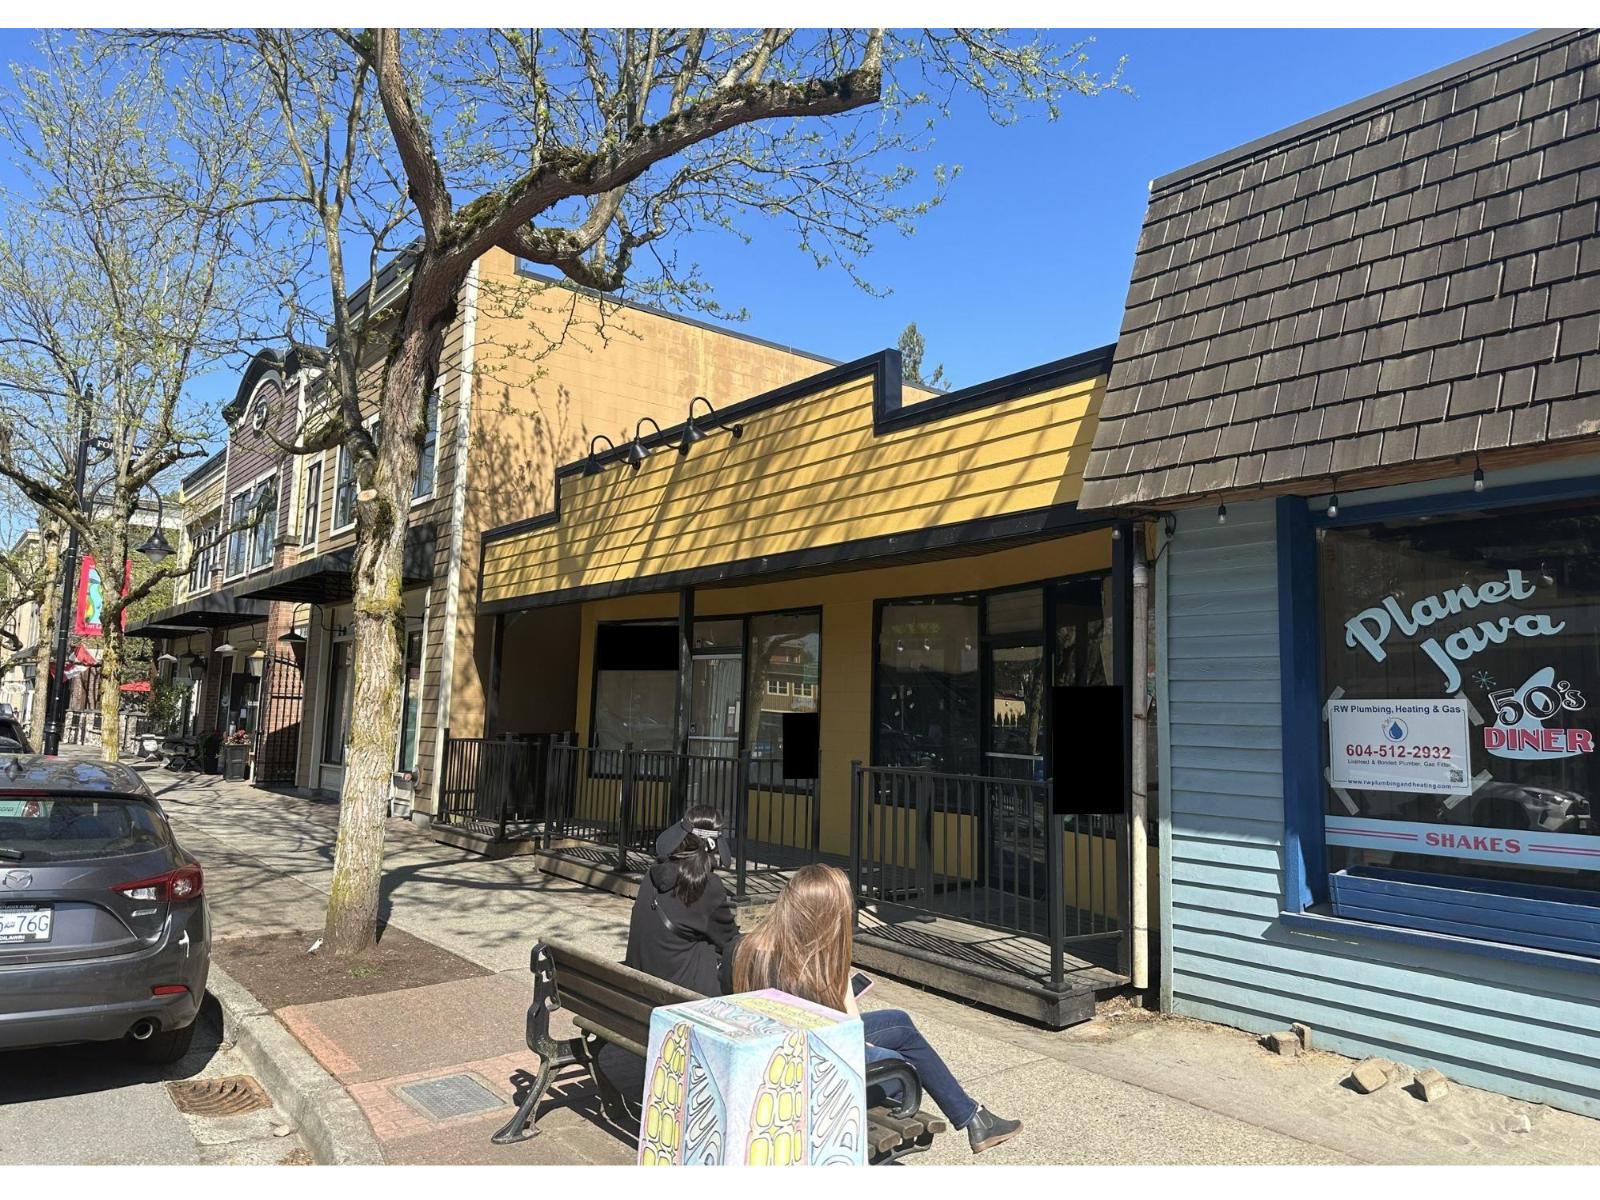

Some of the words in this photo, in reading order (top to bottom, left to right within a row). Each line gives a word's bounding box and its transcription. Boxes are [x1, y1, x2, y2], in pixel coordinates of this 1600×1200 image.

[1345, 569, 1536, 662] Planet
[1420, 614, 1566, 694] Java
[1333, 705, 1348, 713] RW
[1350, 705, 1394, 715] Plumbing,
[1396, 705, 1430, 715] Heating
[1432, 705, 1439, 714] &
[1442, 705, 1461, 714] Gas
[1488, 680, 1586, 726] 50's
[1346, 744, 1451, 760] 604-512-2932
[1484, 726, 1594, 752] DINER
[1425, 832, 1521, 854] SHAKES
